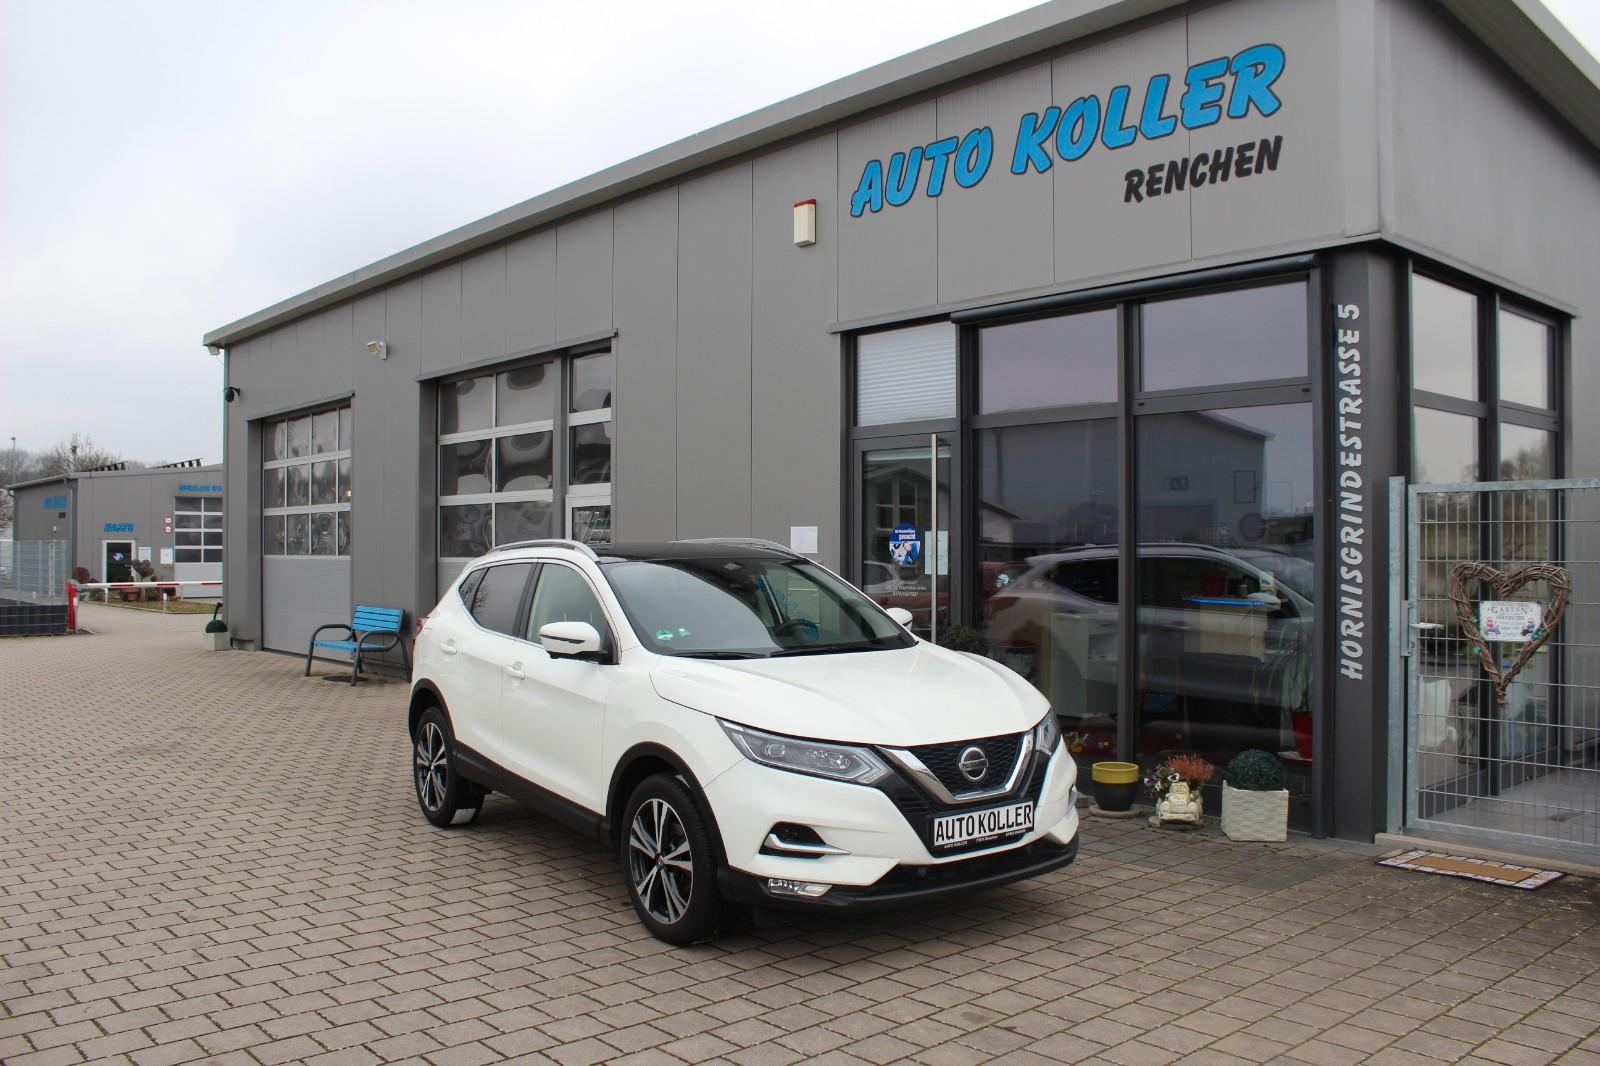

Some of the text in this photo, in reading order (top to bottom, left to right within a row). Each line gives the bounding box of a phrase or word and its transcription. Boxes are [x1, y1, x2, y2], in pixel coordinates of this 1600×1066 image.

[850, 43, 1286, 218] AUTO KOLLER
[1123, 134, 1283, 204] RENCHEN
[1337, 303, 1365, 680] HORNISGRINDESTRASSE 5
[936, 804, 1032, 842] AUTO KOLLER
